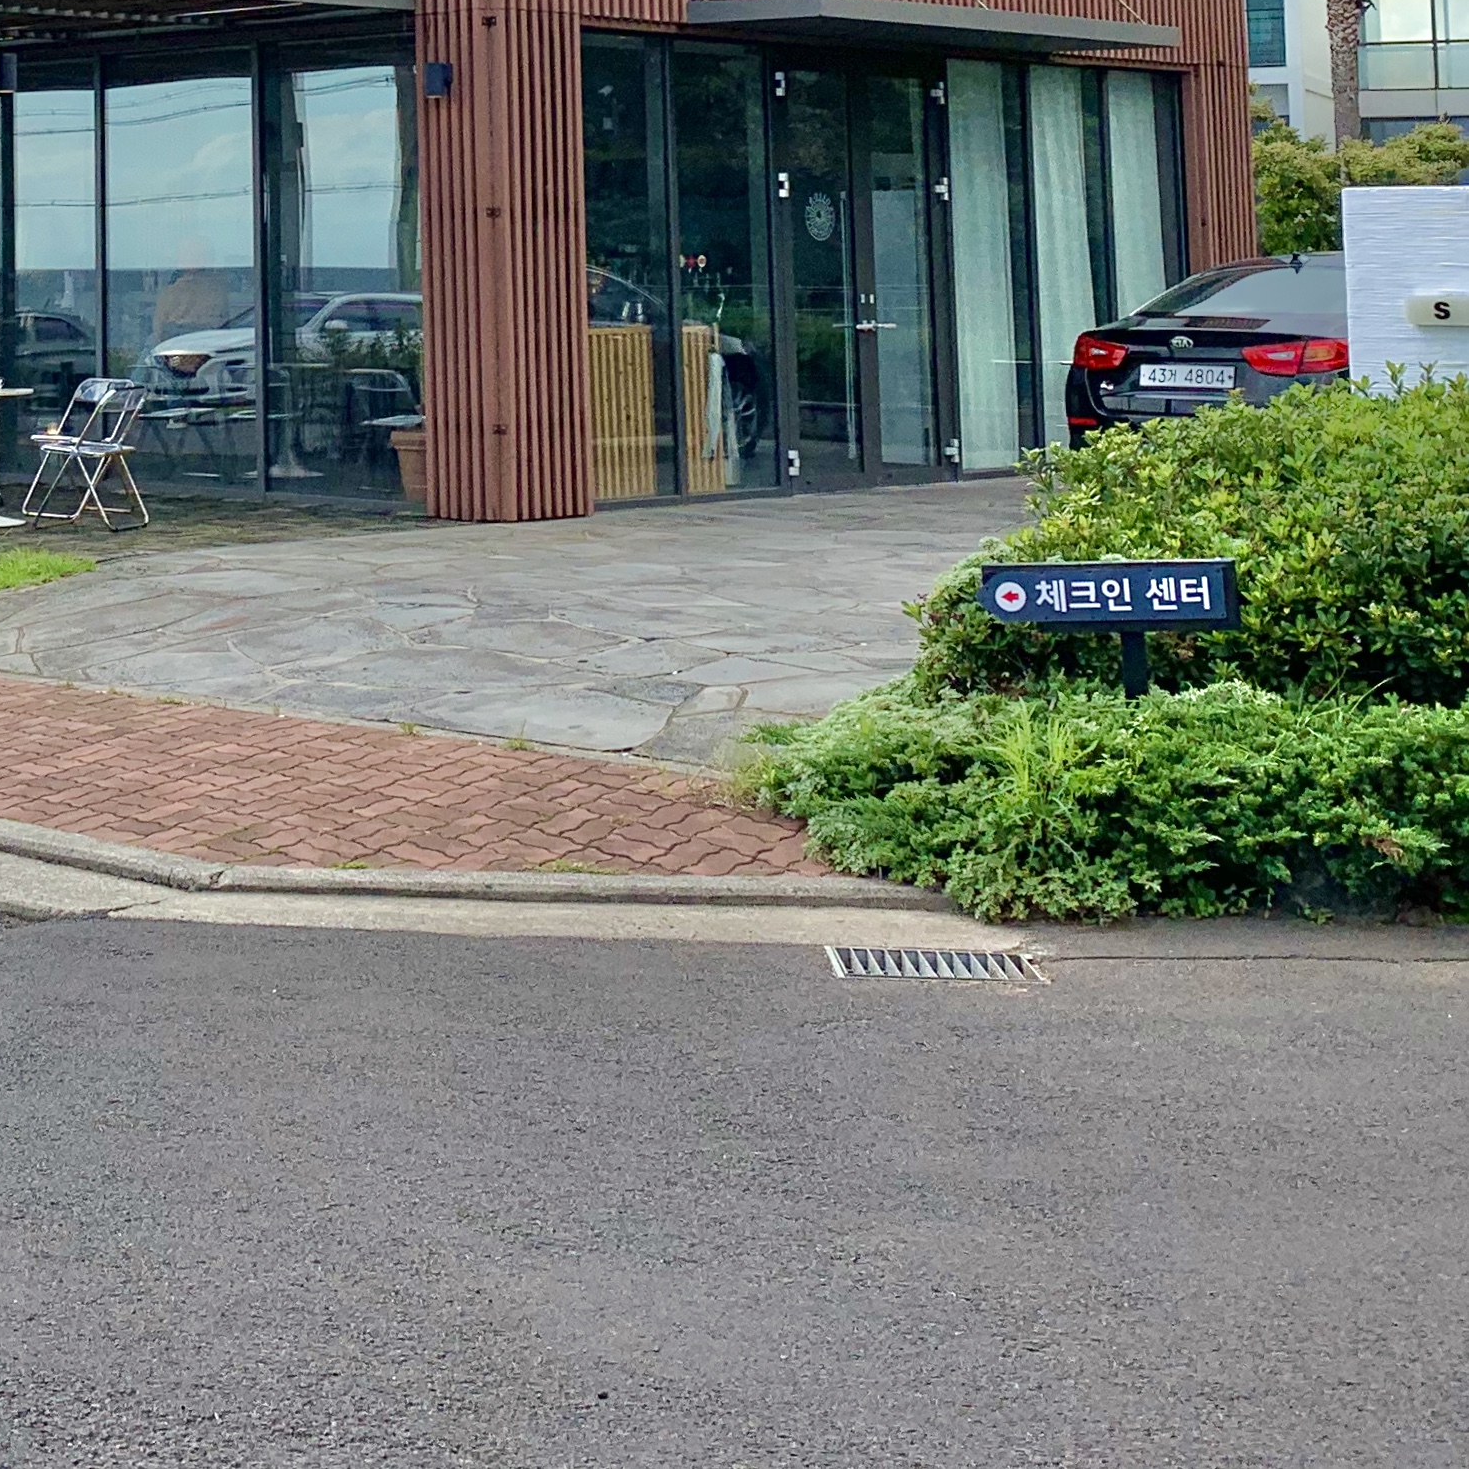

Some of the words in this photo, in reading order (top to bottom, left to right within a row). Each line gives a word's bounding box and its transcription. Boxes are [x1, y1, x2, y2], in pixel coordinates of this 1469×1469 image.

[1433, 301, 1451, 320] S
[1148, 368, 1177, 383] 43거
[1184, 369, 1225, 385] 4804
[1035, 578, 1132, 612] 체크인
[1145, 576, 1211, 610] 센터
